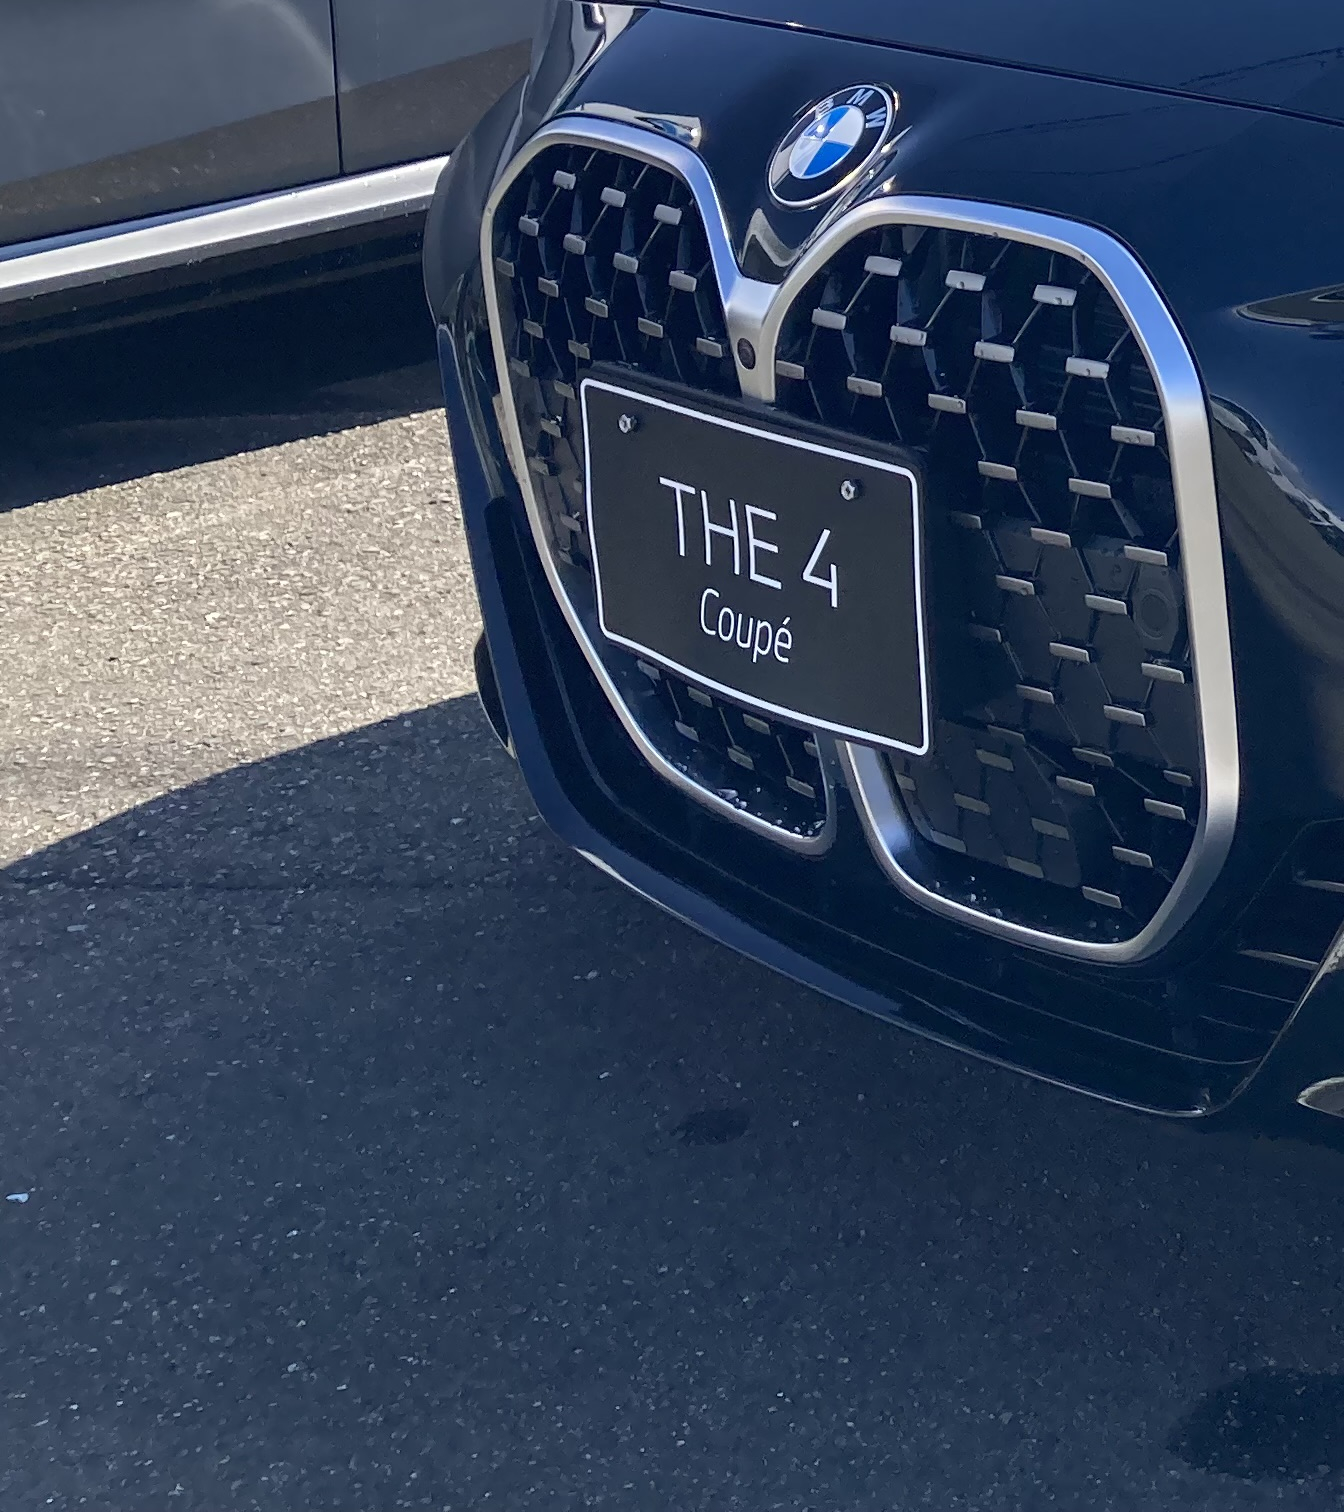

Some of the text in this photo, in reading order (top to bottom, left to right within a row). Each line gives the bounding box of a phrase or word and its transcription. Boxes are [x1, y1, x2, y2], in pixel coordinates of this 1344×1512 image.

[815, 88, 887, 128] BMW
[658, 476, 839, 608] THE 4
[700, 587, 793, 663] Coupé
